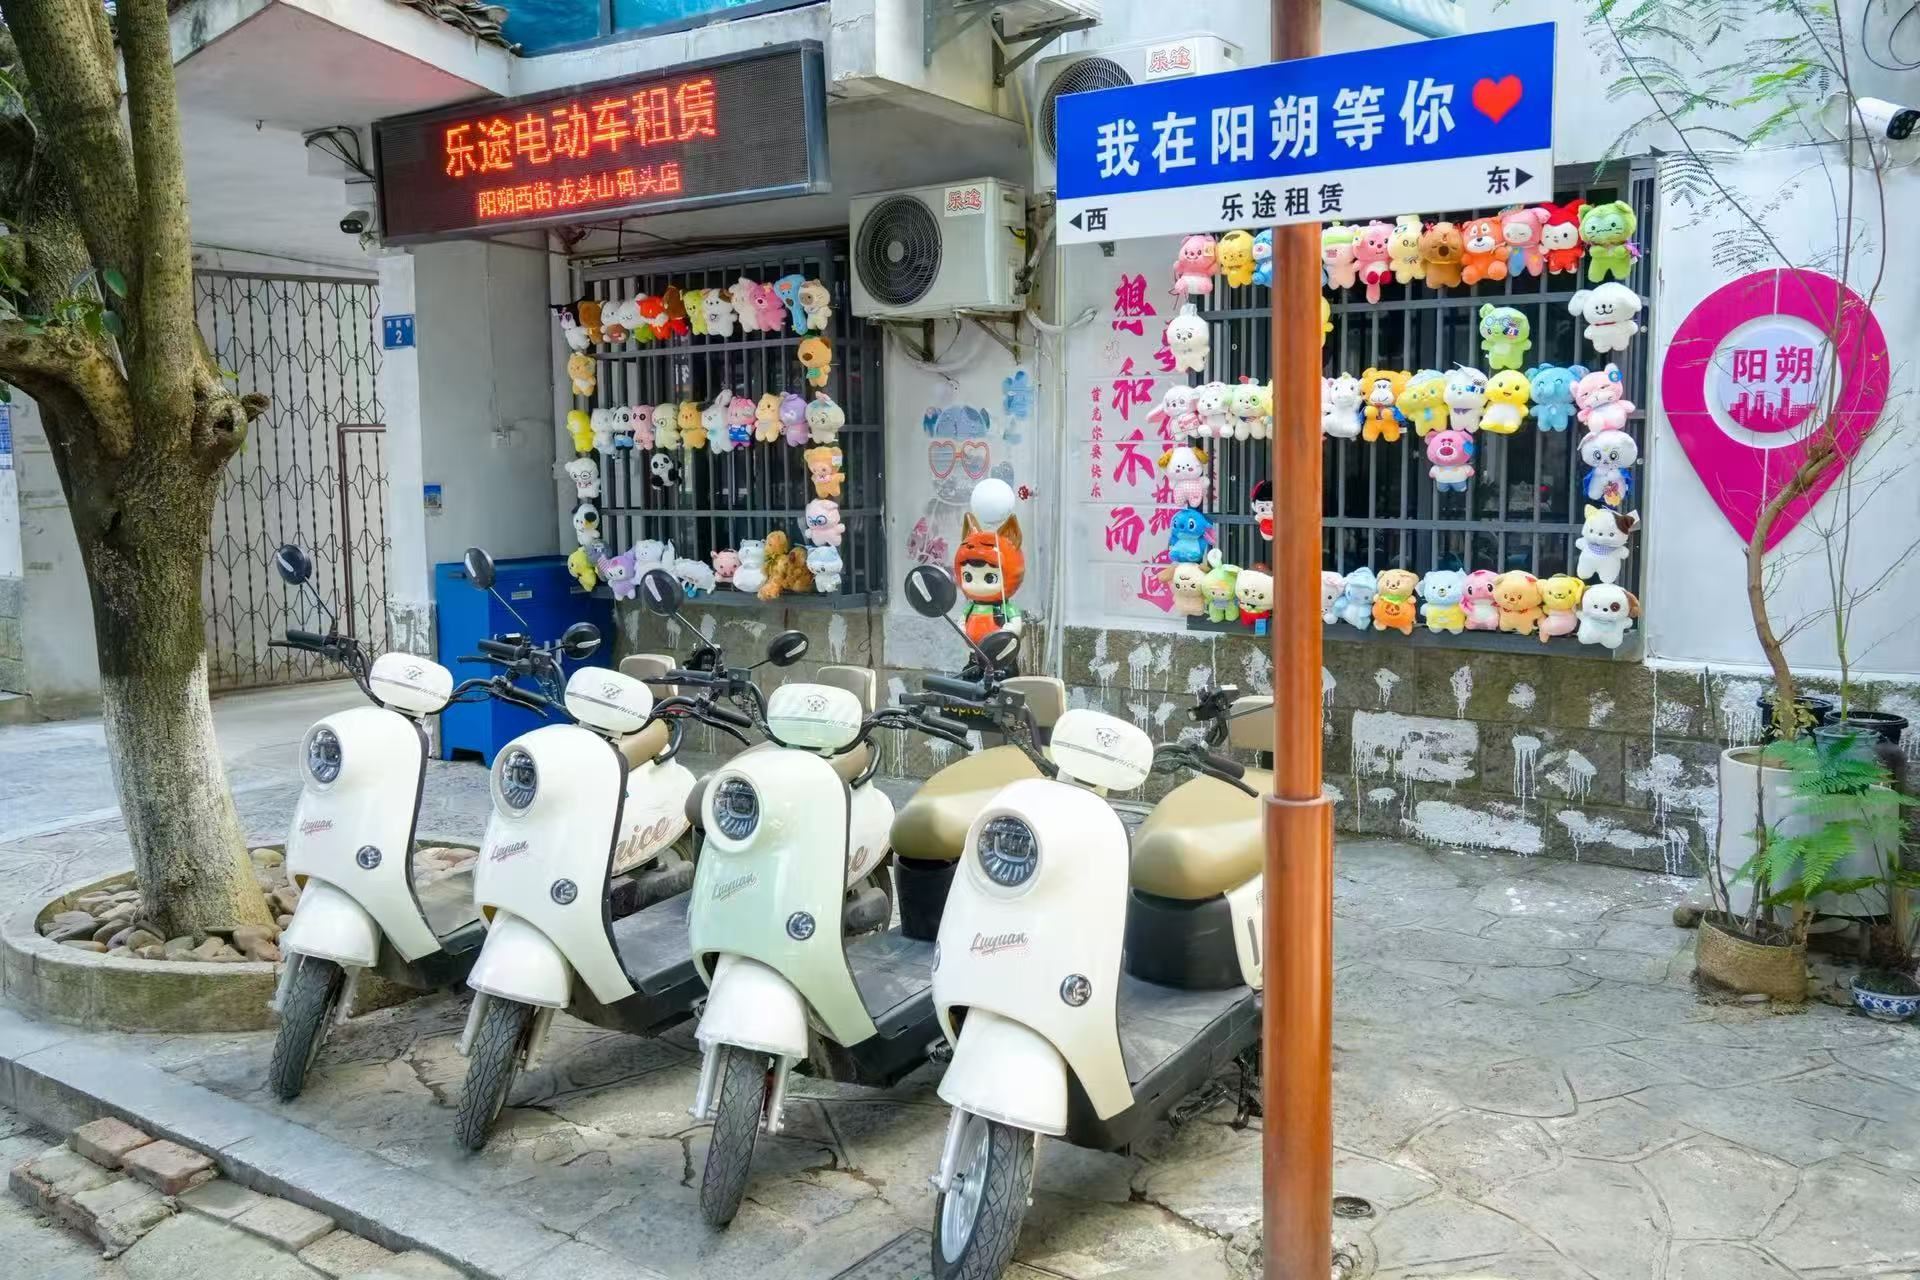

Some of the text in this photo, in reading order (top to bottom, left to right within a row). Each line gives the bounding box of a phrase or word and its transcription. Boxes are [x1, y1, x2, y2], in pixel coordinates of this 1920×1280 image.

[1149, 46, 1191, 73] 乐途
[446, 79, 716, 176] 乐途电动车租赁
[1096, 77, 1456, 179] 我在阳朔等你
[1487, 166, 1510, 194] 东
[947, 188, 982, 211] 乐途
[1221, 183, 1344, 222] 乐途租赁
[1085, 207, 1109, 232] 西
[395, 329, 403, 344] 2
[1732, 345, 1814, 384] 阳朔
[490, 840, 529, 862] Luyuan
[969, 931, 1028, 955] Luyuan
